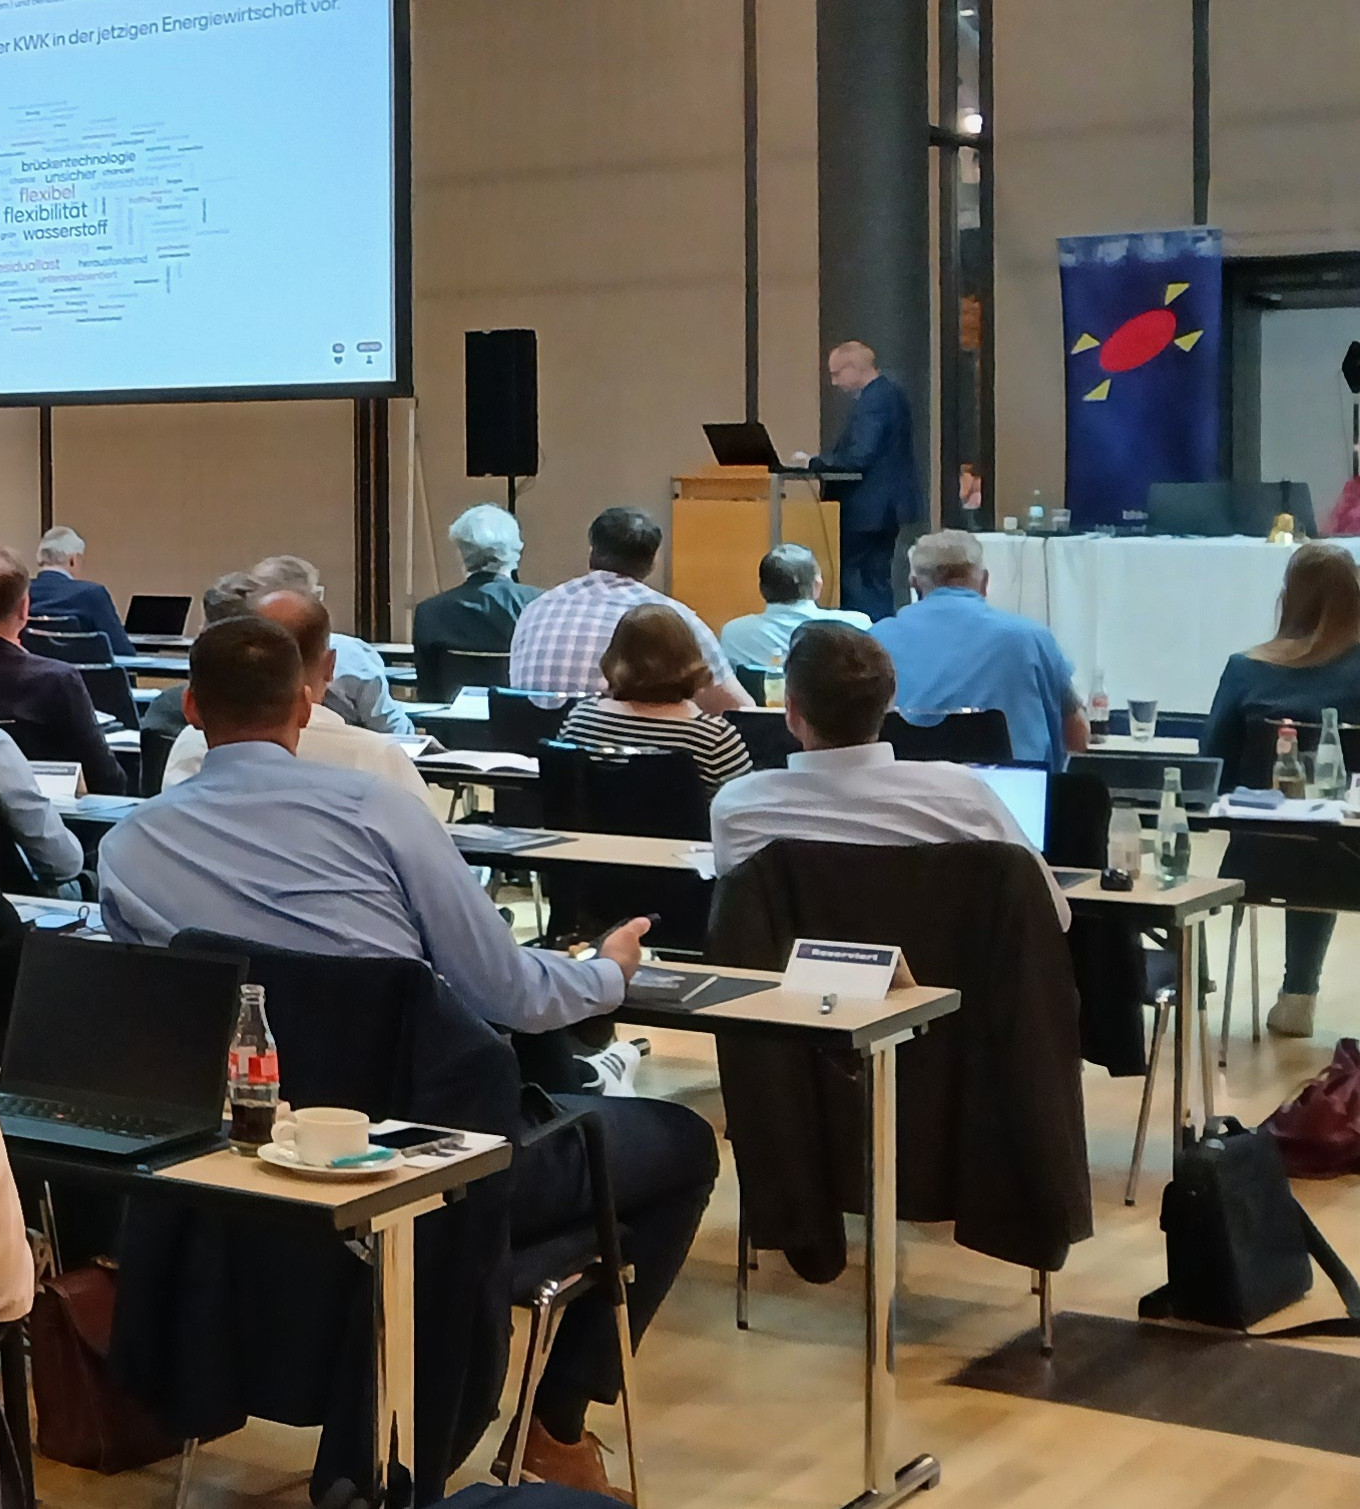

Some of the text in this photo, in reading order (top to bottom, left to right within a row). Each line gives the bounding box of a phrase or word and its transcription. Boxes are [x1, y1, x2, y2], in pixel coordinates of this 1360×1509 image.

[13, 33, 50, 52] KWK
[52, 32, 66, 47] in
[68, 28, 94, 45] der
[96, 20, 159, 45] jetzigen
[162, 0, 307, 33] Energiewirtschaft
[311, 0, 341, 13] vor.
[21, 151, 137, 173] brückentechnologie
[45, 169, 98, 184] unsicher
[19, 183, 76, 204] flexibel
[3, 201, 89, 224] flexibilität
[22, 219, 109, 242] wasserstoff
